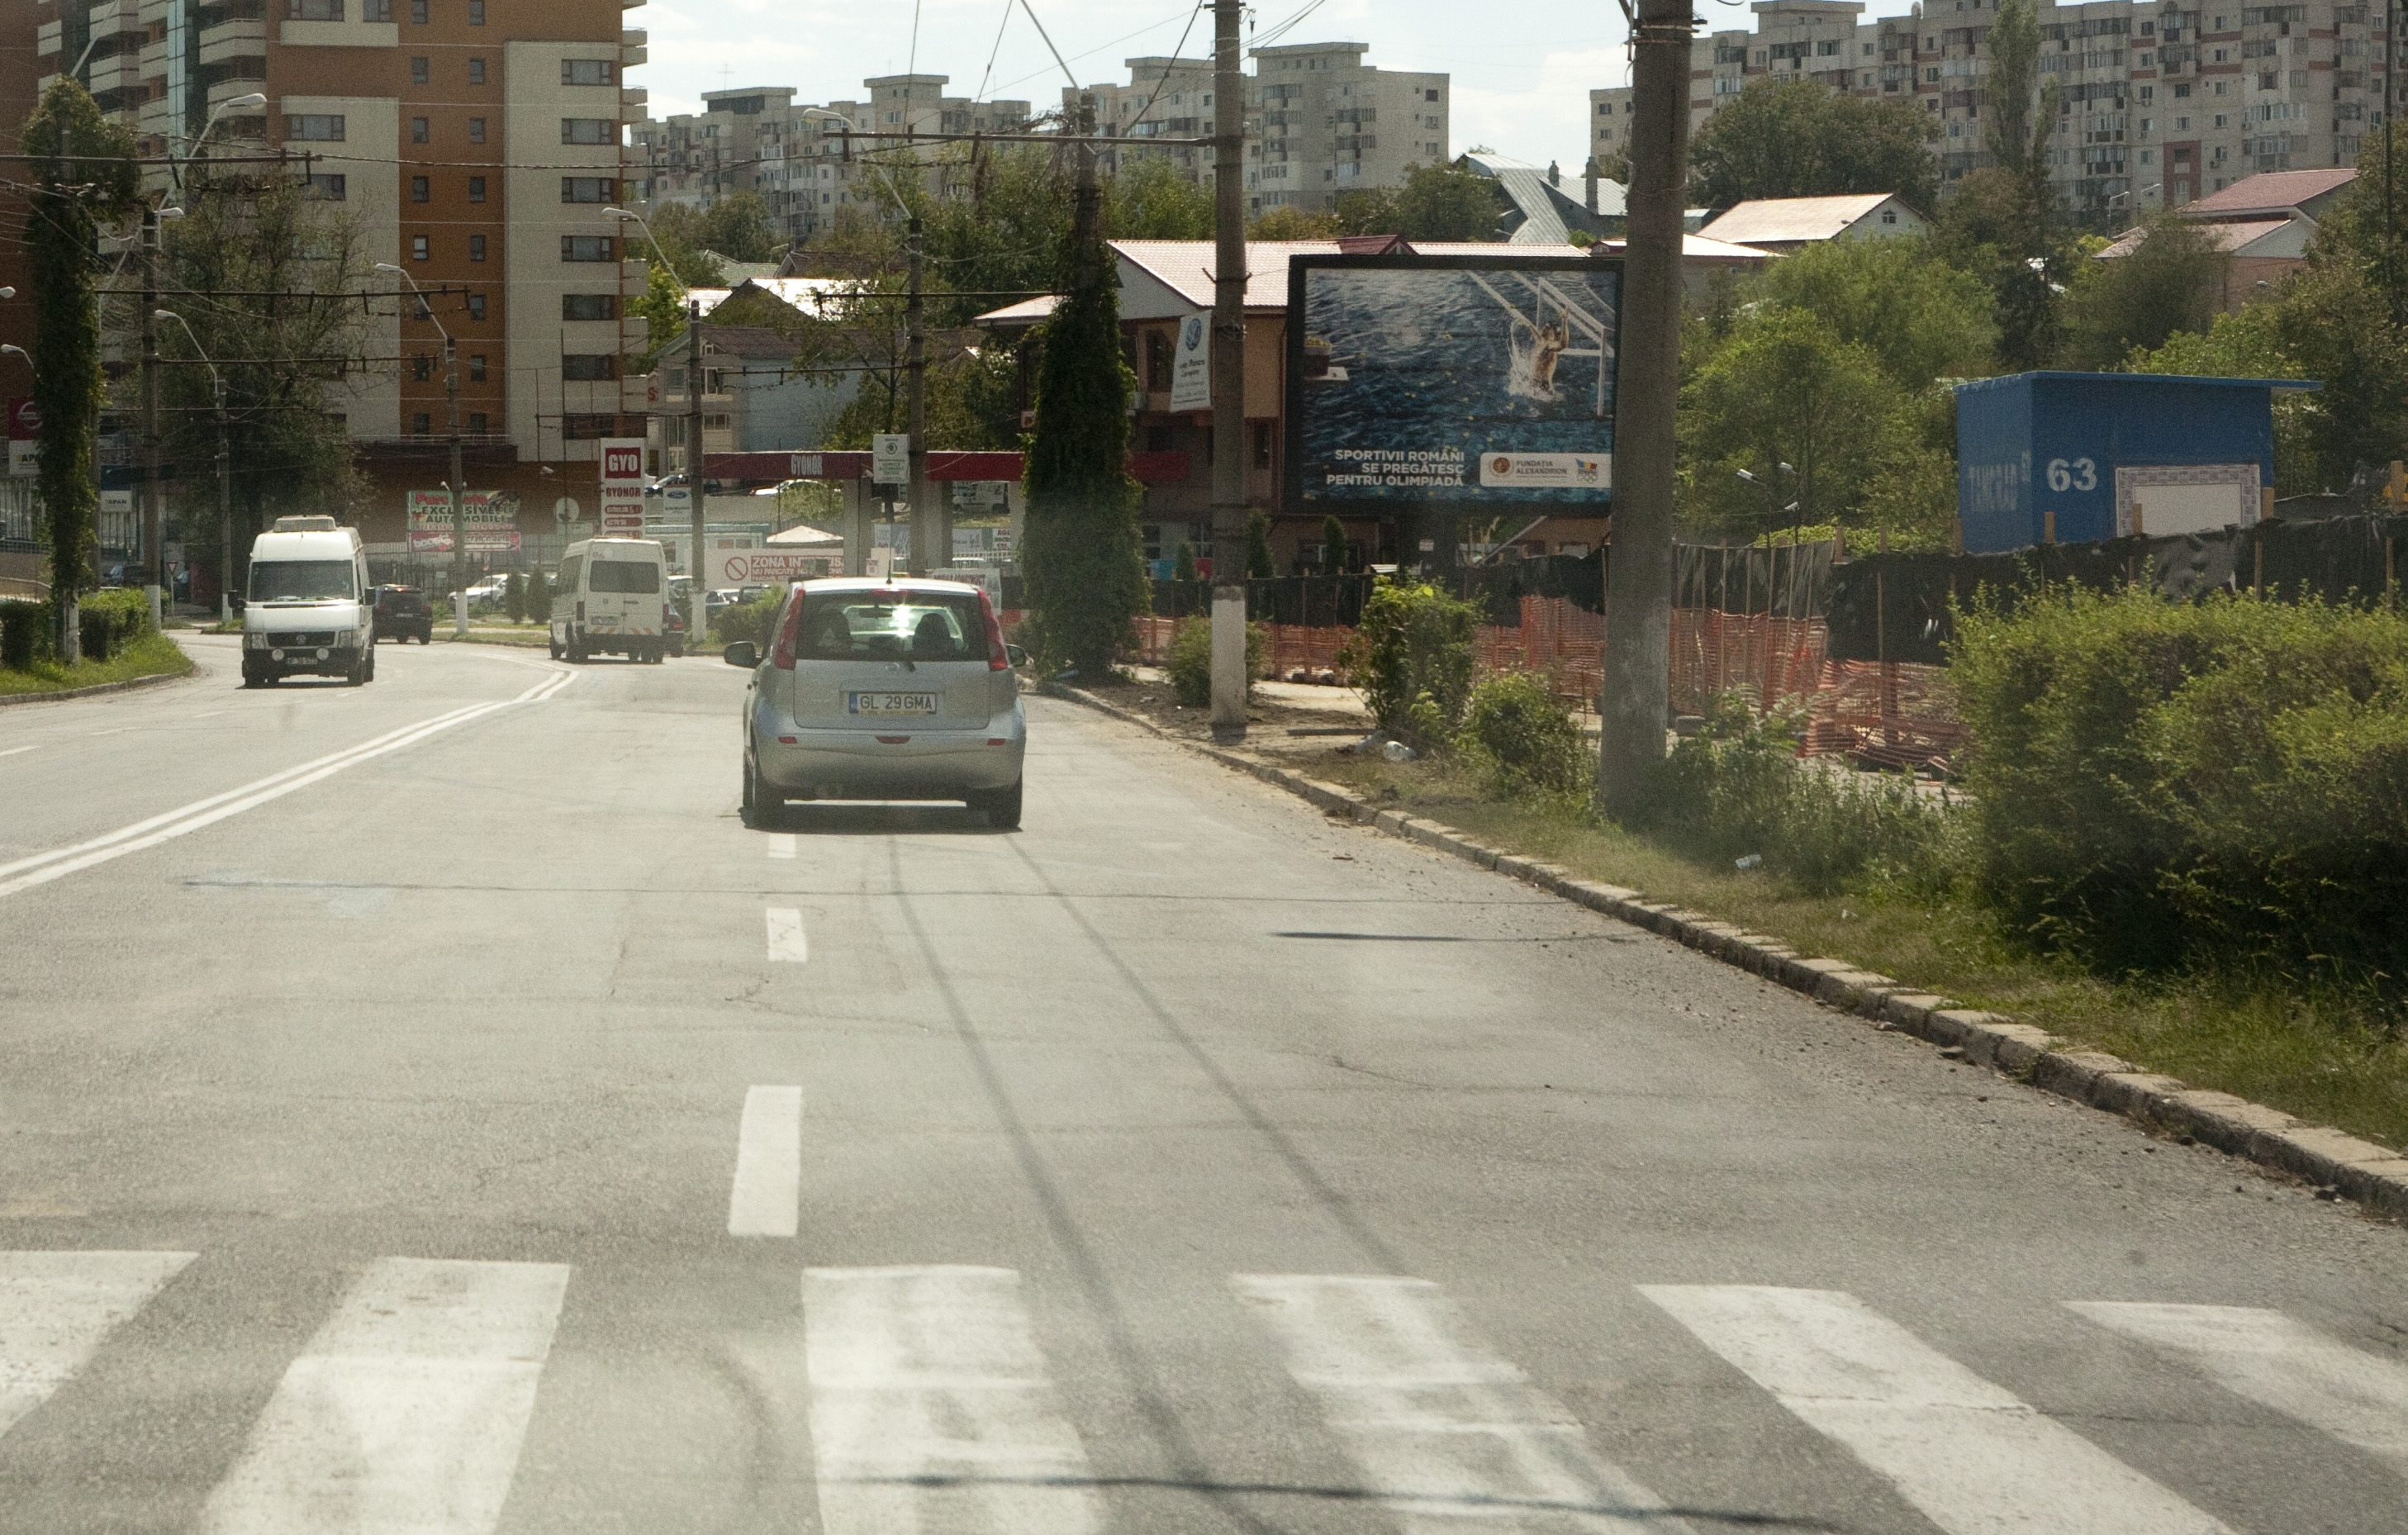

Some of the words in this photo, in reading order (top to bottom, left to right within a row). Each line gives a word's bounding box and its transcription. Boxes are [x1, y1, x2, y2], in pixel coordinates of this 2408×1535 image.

[1335, 449, 1404, 461] SPORTIVII
[1408, 449, 1465, 462] ROMÂNI
[608, 454, 639, 473] GYO
[791, 454, 823, 476] GYONOR
[1361, 463, 1380, 473] SE
[1383, 461, 1465, 474] PREGĂTESC
[1327, 474, 1383, 486] PENTRU
[1386, 473, 1464, 487] OLIMPIADĂ
[2046, 457, 2098, 492] 63
[606, 487, 641, 497] GYONOR
[421, 506, 496, 515] EXCLSIVE
[426, 515, 505, 523] AUTMOBIL
[753, 557, 786, 568] ZONA
[860, 696, 879, 710] GL
[885, 696, 902, 710] 29
[904, 696, 933, 710] GMA
